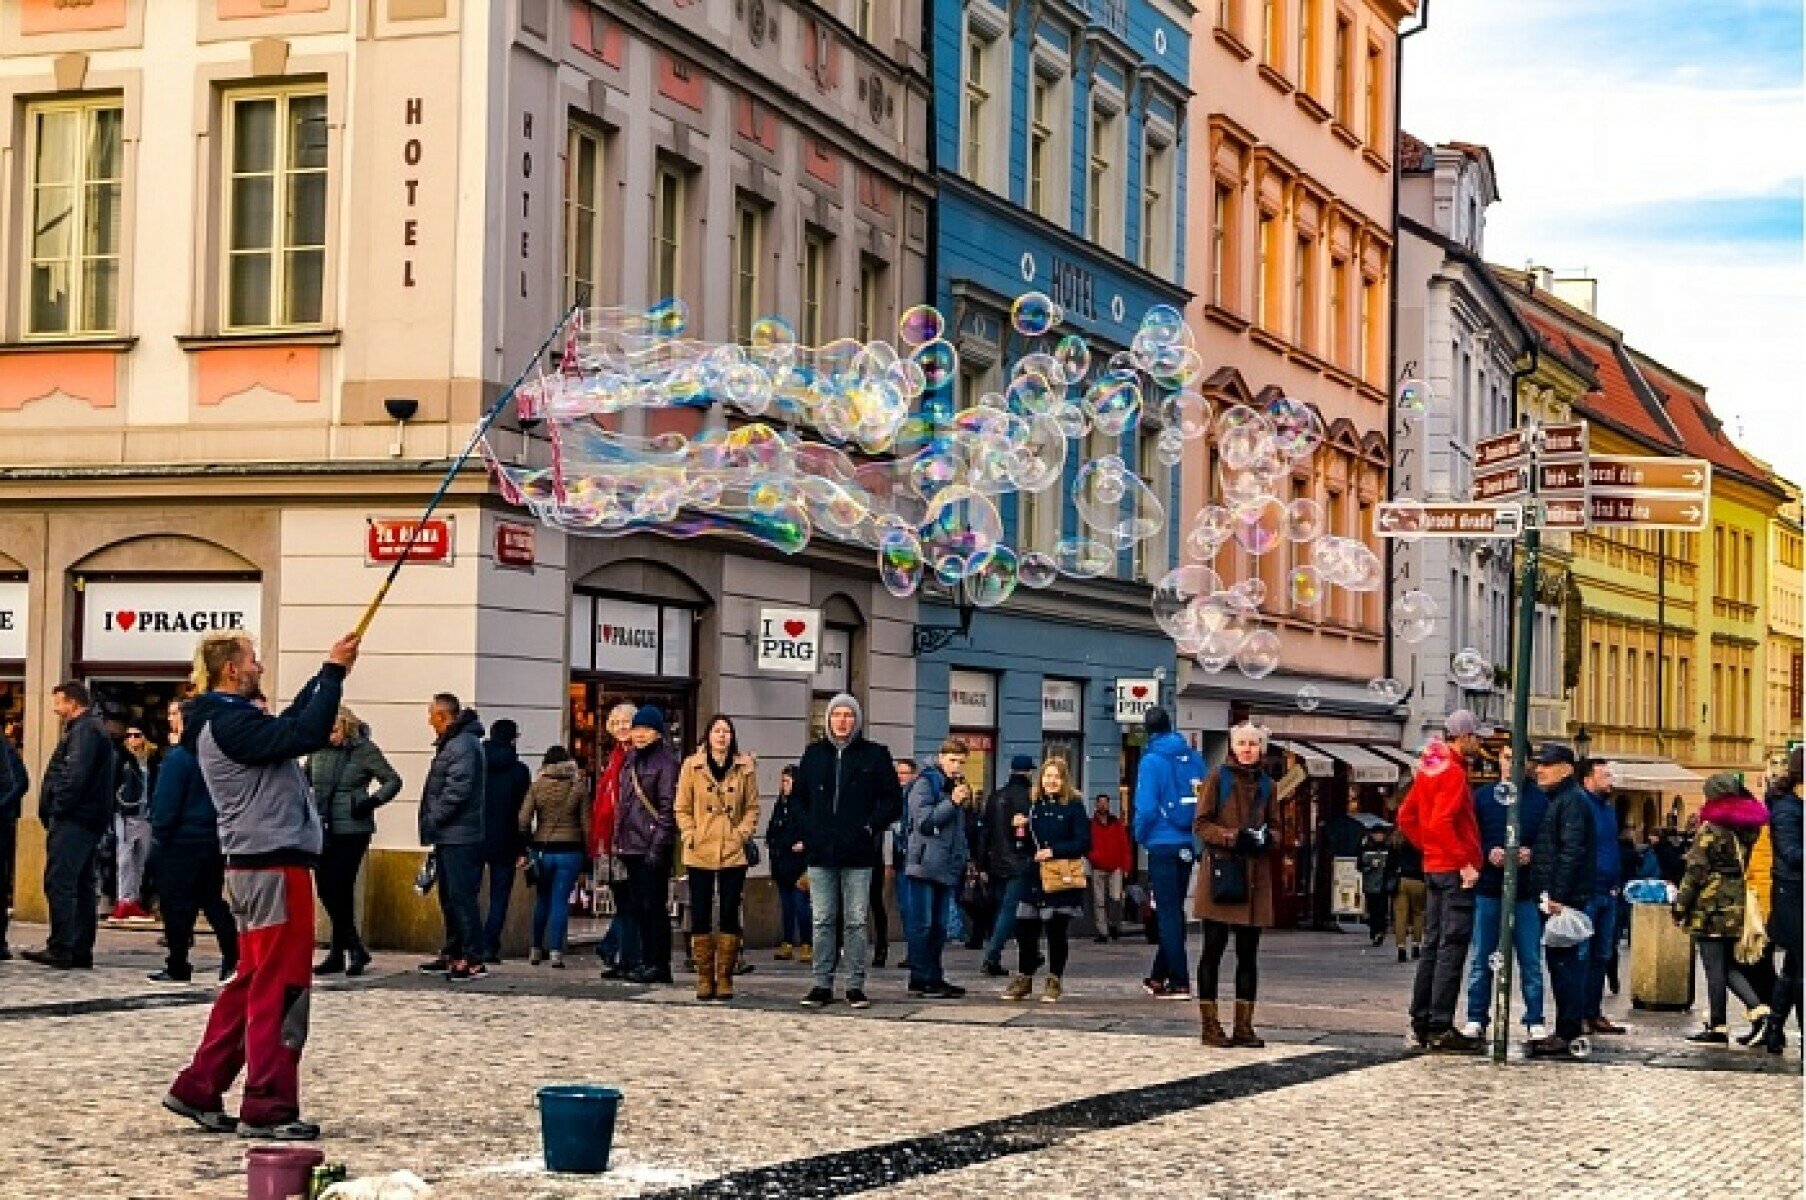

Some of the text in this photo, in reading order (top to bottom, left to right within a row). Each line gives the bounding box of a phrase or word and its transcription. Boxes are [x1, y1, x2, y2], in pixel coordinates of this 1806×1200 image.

[403, 98, 423, 287] HOTEL
[520, 111, 533, 298] HOTEL
[1050, 256, 1097, 320] HOTEL
[104, 611, 245, 632] I PRAGUE
[763, 619, 774, 637] I
[611, 626, 657, 649] PRAGUE
[761, 639, 813, 659] PRG
[1118, 686, 1125, 699] I
